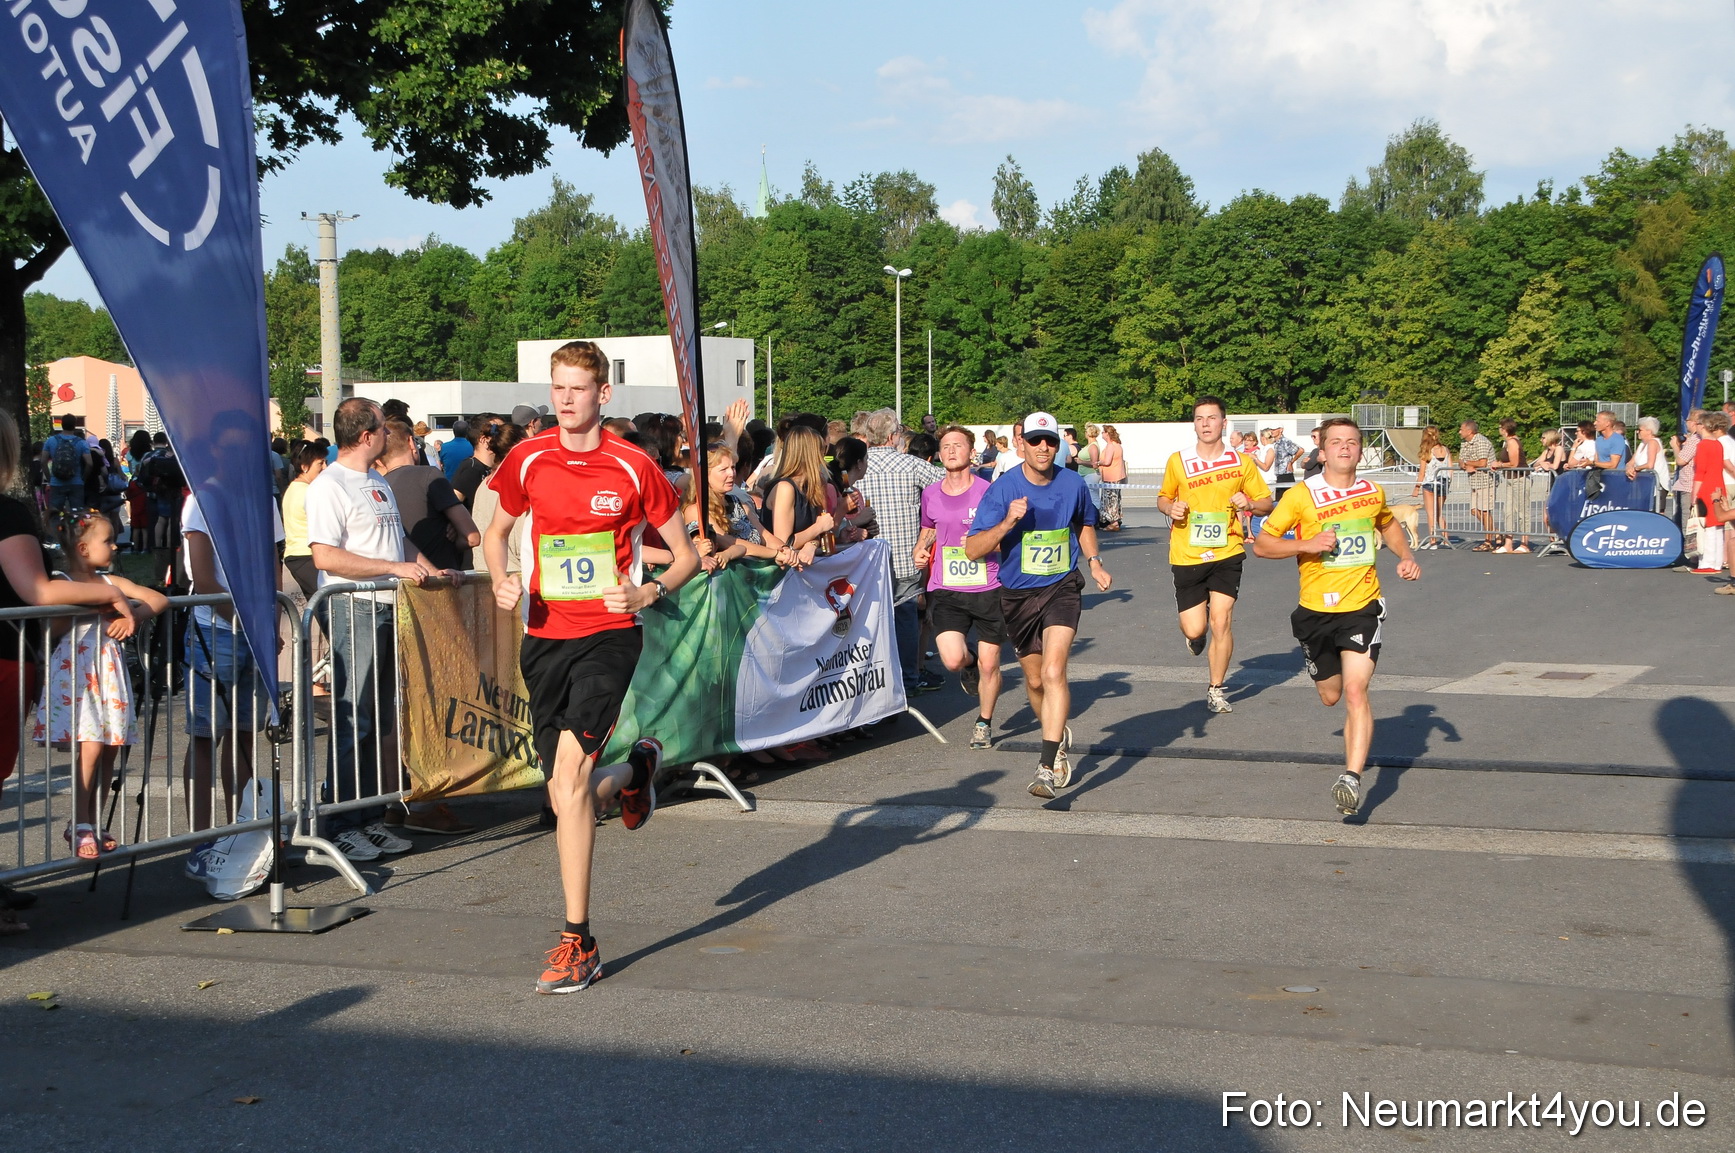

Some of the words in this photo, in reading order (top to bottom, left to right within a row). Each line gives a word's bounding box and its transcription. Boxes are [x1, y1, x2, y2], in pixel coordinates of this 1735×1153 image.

[1188, 476, 1213, 490] MAX
[1215, 469, 1244, 483] BÖGL
[1316, 504, 1349, 521] MAX
[1351, 496, 1382, 510] BÖGL
[1194, 523, 1222, 539] 759
[1598, 535, 1670, 549] Fischer
[1029, 544, 1062, 564] 721
[1604, 548, 1664, 557] AUTOMOBILE
[559, 556, 596, 584] 19
[948, 560, 979, 576] 609
[444, 696, 539, 770] Lamm
